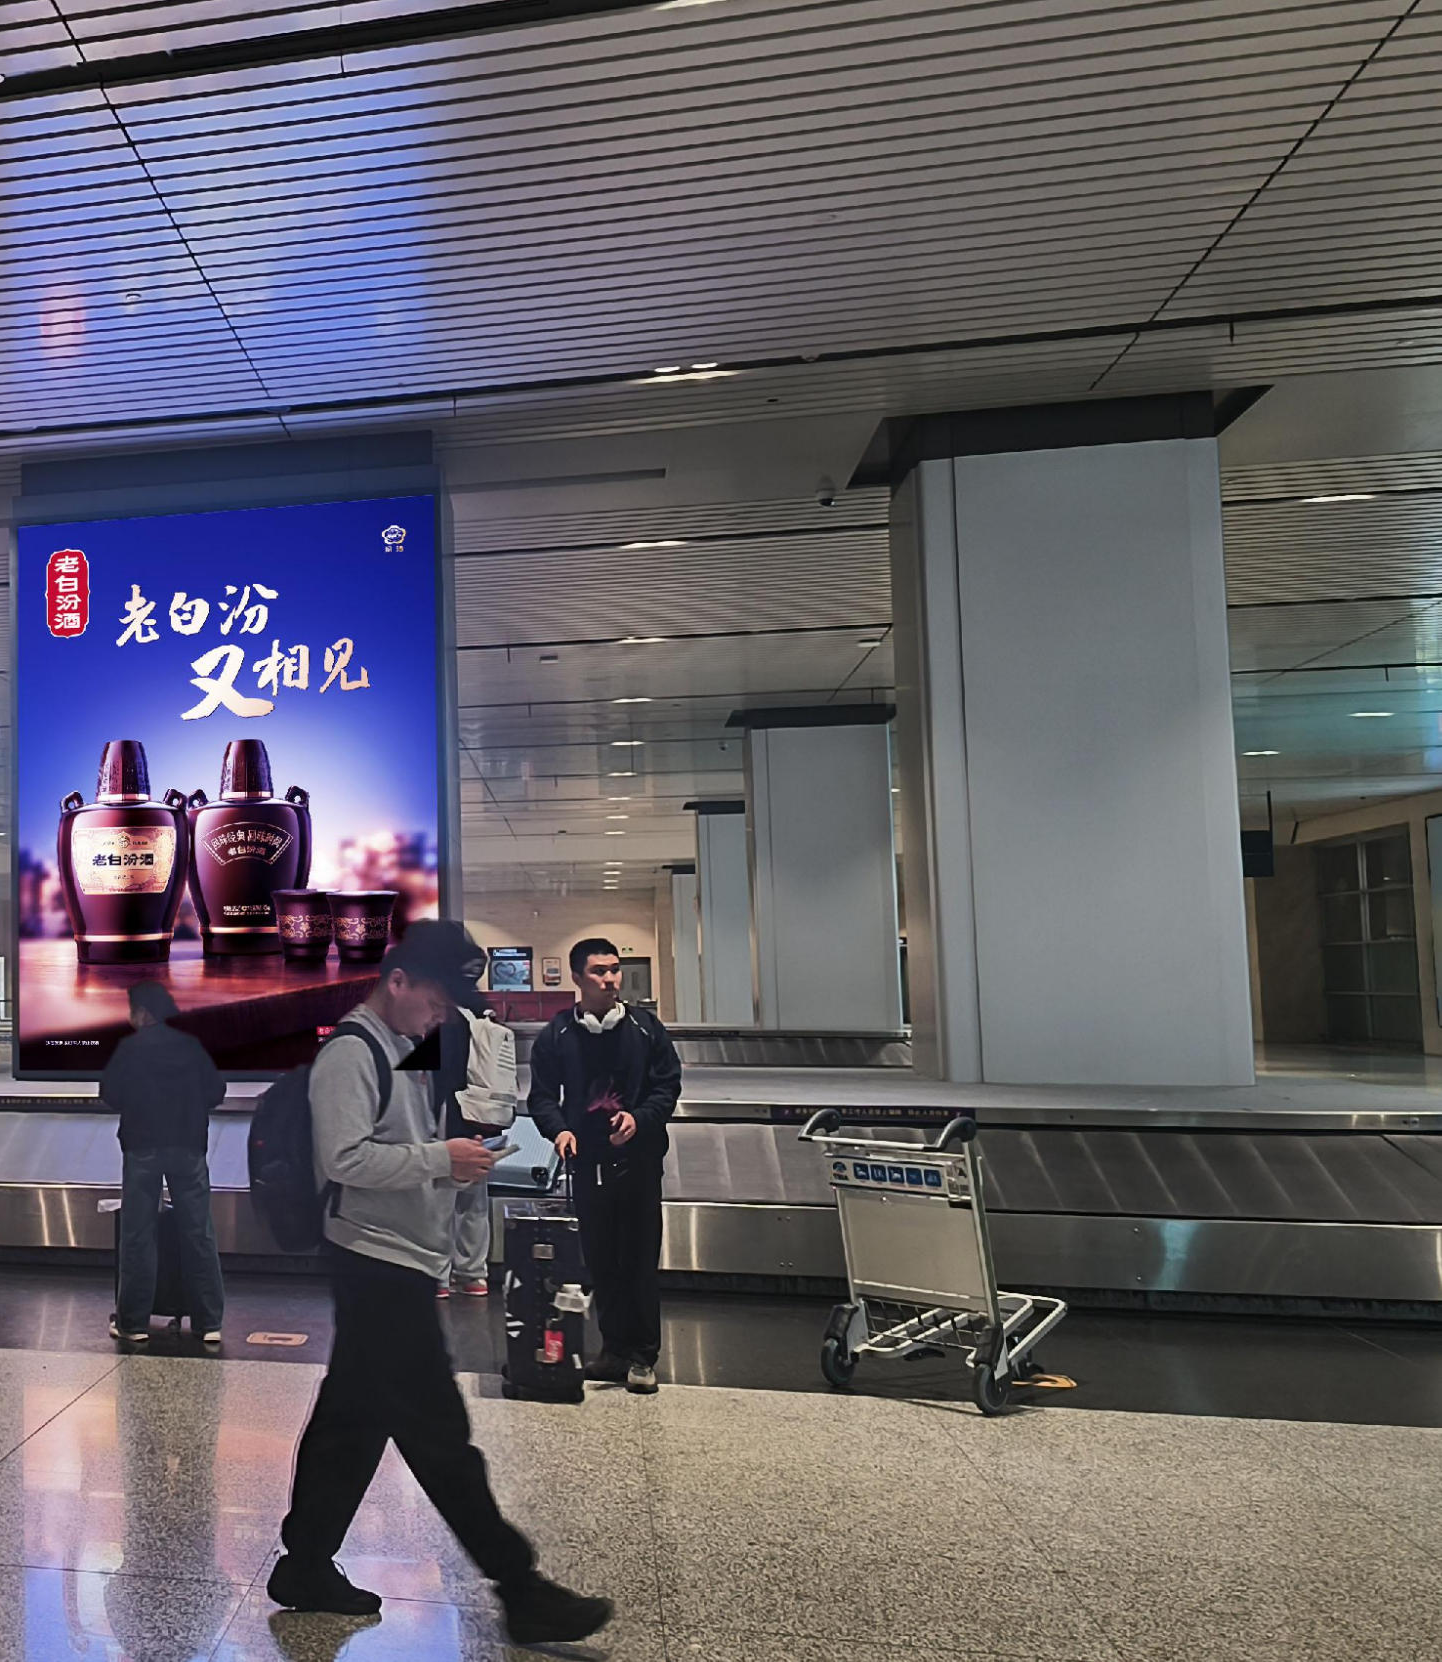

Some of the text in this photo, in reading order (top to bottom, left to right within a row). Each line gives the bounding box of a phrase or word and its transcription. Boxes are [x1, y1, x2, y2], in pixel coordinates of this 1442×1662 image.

[54, 555, 82, 630] 老白汾酒
[115, 583, 279, 647] 老白汾
[180, 637, 371, 721] 又相见
[92, 853, 155, 866] 老白汾酒
